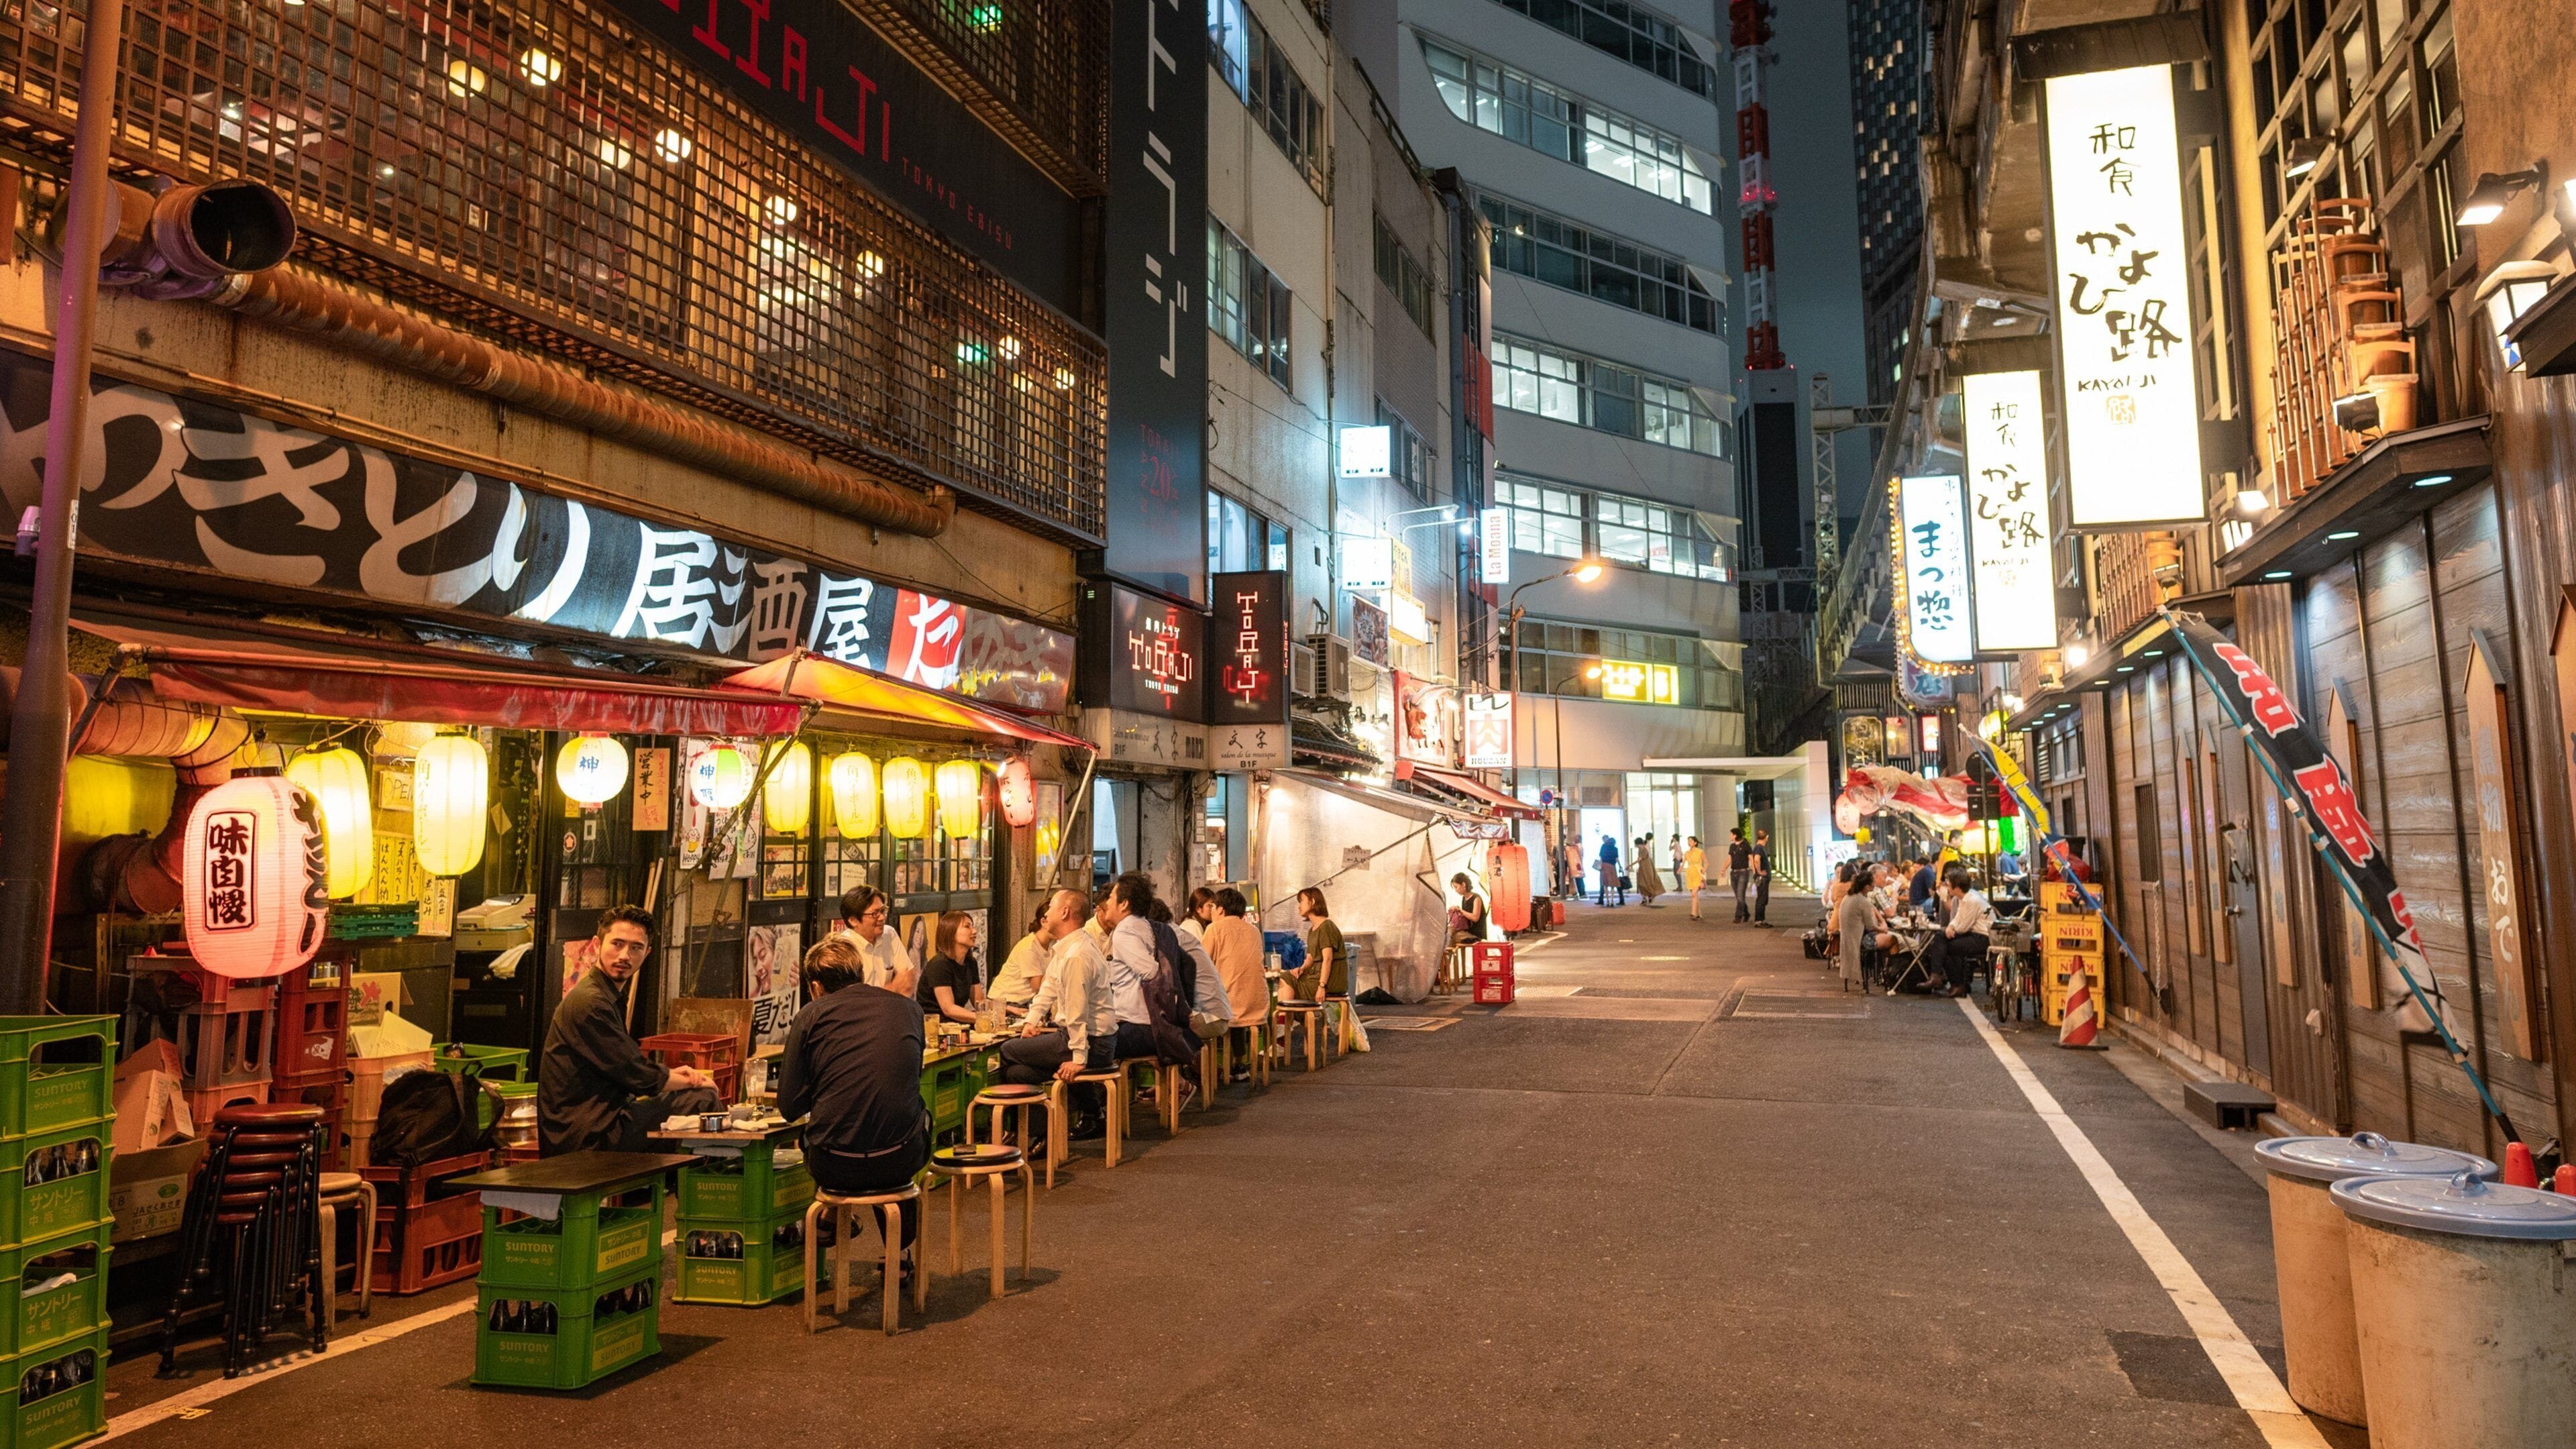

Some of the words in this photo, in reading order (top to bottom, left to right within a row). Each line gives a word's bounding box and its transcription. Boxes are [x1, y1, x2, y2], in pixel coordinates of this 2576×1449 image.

[2089, 123, 2141, 196] 和食
[1143, 0, 1187, 378] トラジ
[902, 157, 956, 211] TOKYO
[967, 205, 1012, 250] EBISU
[1488, 515, 1501, 559] Moana
[1488, 561, 1501, 576] La
[610, 521, 873, 664] 居酒屋
[1129, 630, 1193, 682] TORAJI
[1236, 591, 1259, 704] TORAJI
[1114, 744, 1126, 755] B1F
[1229, 728, 1268, 749] 文字
[1240, 760, 1257, 768] B1F
[1252, 751, 1277, 761] musique
[639, 749, 653, 806] 営業中
[209, 816, 250, 925] 味自慢
[379, 843, 389, 903] はんぺん納
[2059, 926, 2093, 936] KIRIN
[34, 1079, 89, 1098] SUNTORY
[30, 1187, 85, 1210] サントリー
[697, 1183, 739, 1192] SUNTORY
[505, 1241, 555, 1254] SUNTORY
[605, 1244, 641, 1265] SUNTORY
[696, 1265, 737, 1275] SUNTORY
[28, 1292, 82, 1320] サントリー
[499, 1341, 549, 1353] SUNTORY
[25, 1395, 81, 1425] SUNTORY
